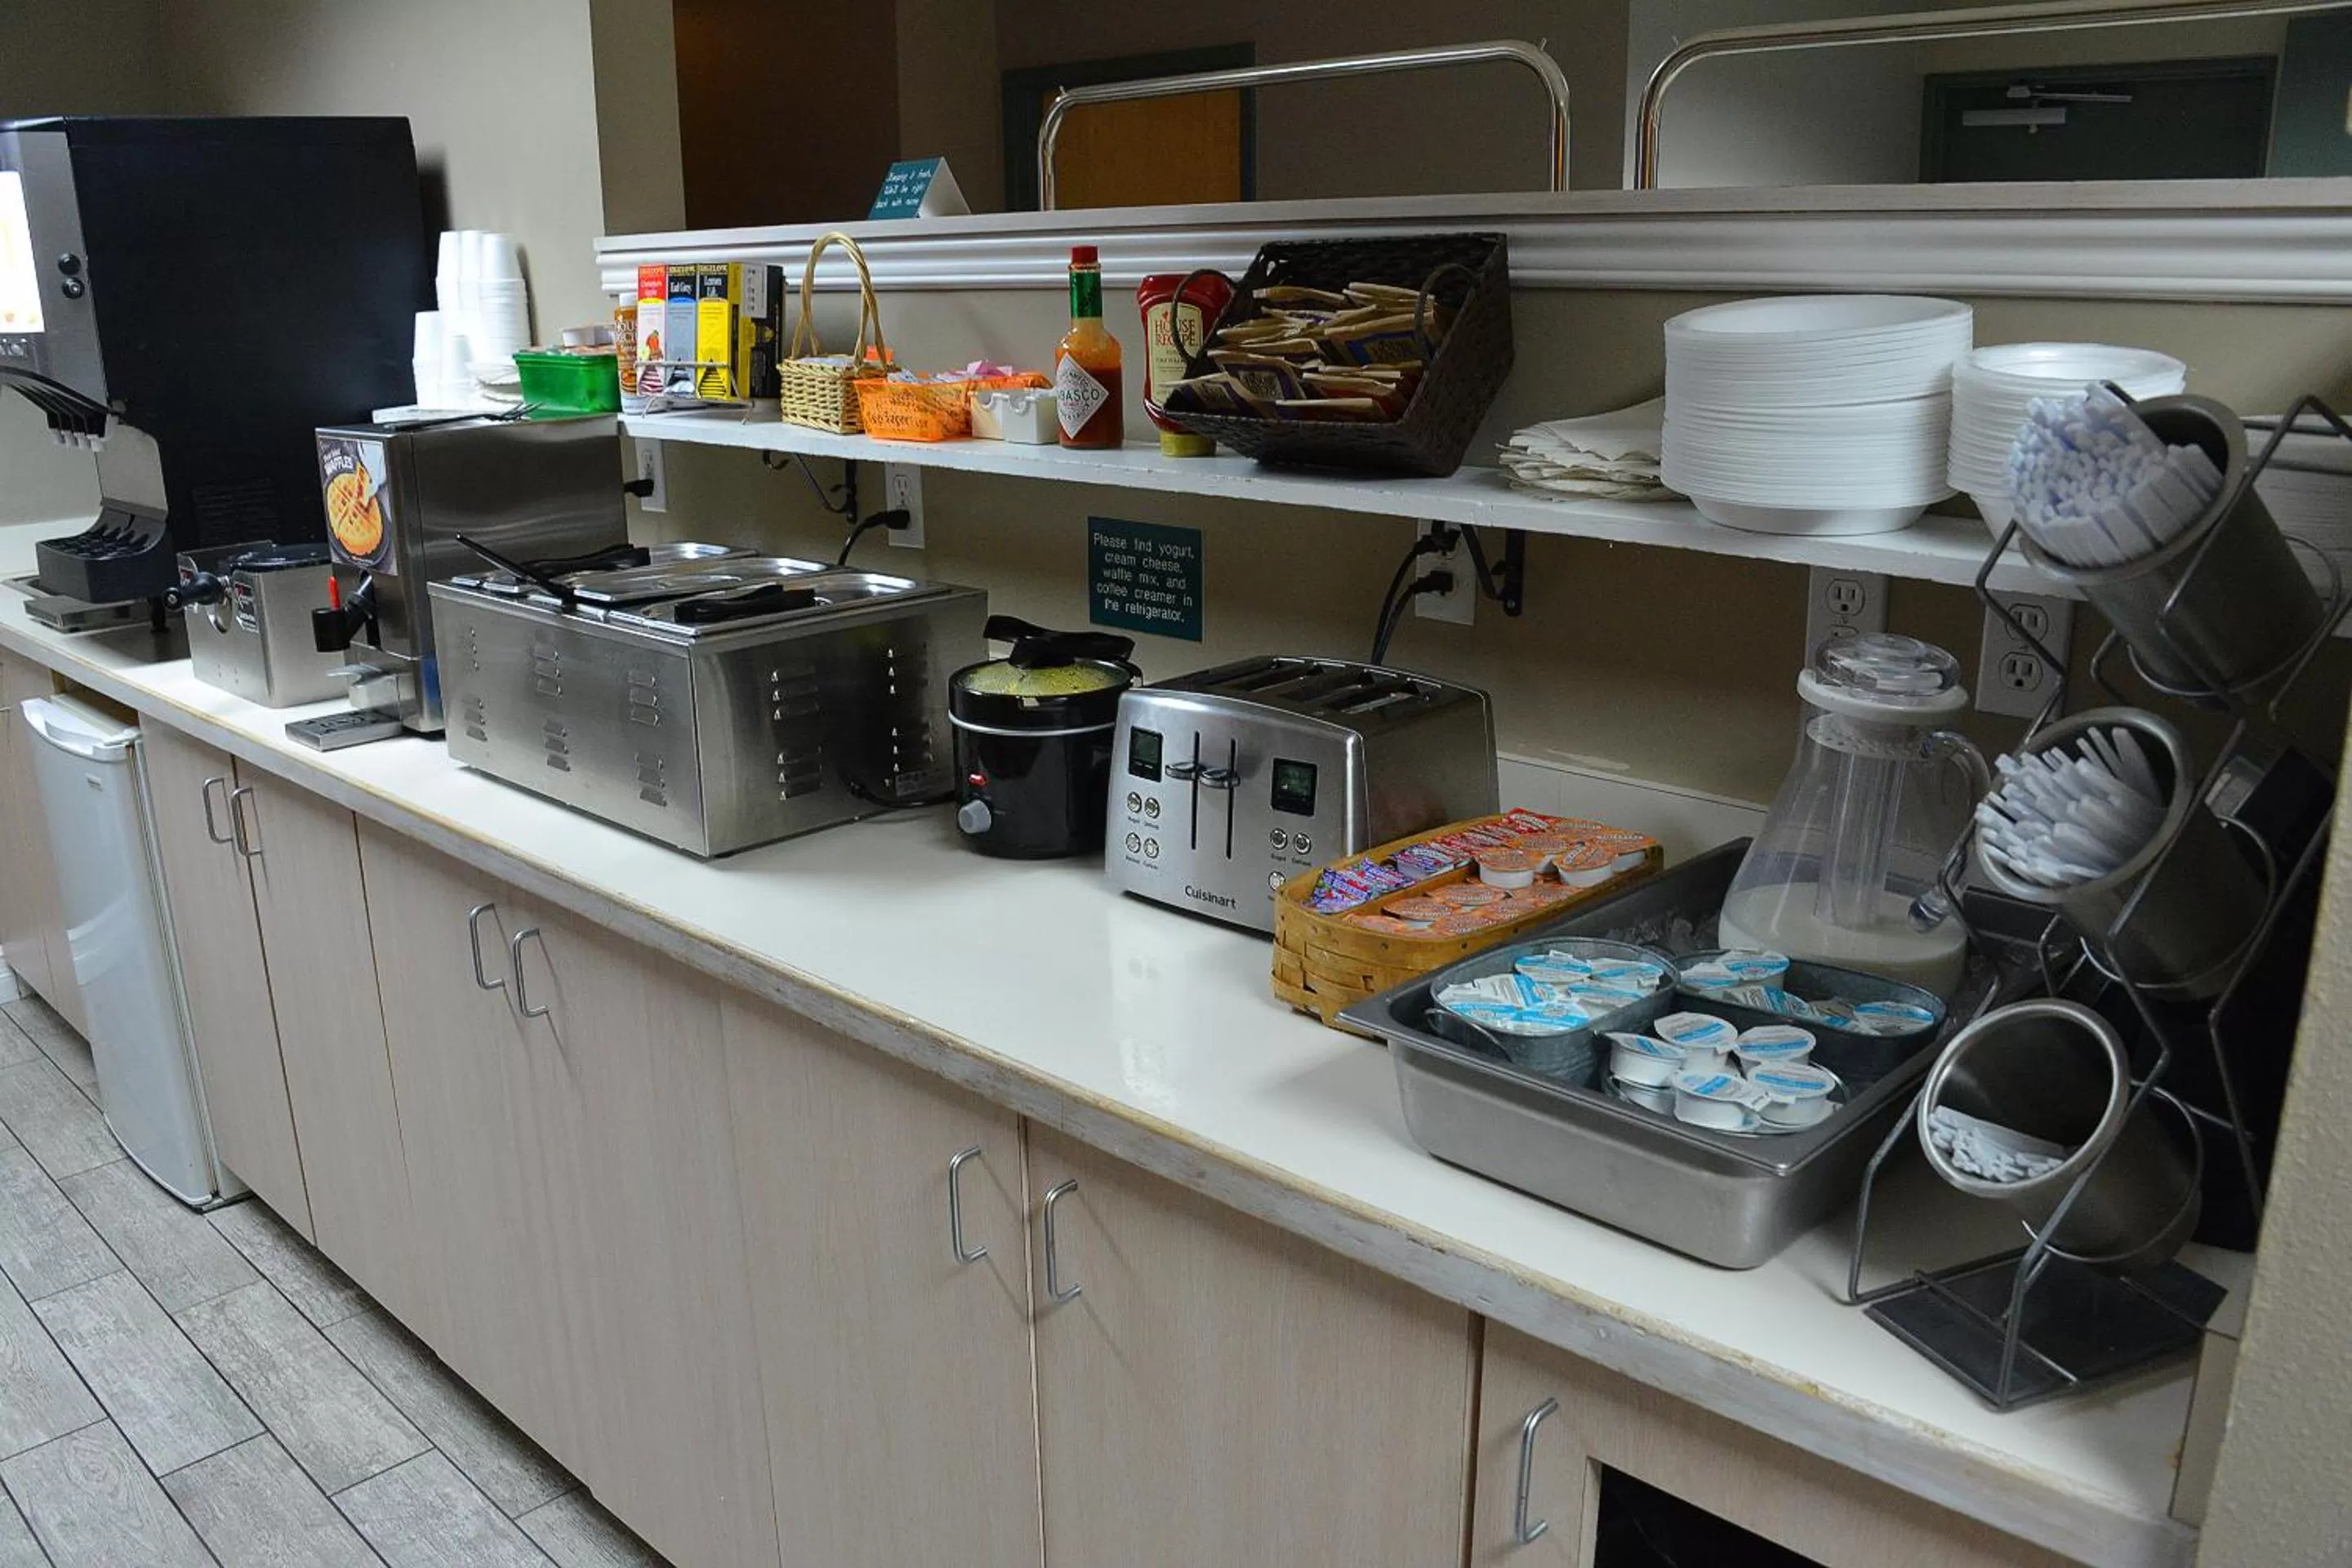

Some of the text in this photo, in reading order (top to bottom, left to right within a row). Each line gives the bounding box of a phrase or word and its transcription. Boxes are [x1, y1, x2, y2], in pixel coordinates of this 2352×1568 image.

[1057, 389, 1100, 401] BASCO
[1094, 532, 1195, 559] Please find yogurt,
[1104, 551, 1183, 573] cream cheese,
[1096, 582, 1193, 607] coffee creamer in
[1165, 577, 1187, 590] and
[1104, 598, 1184, 623] the refrigerator.
[1185, 885, 1236, 910] Cuisinart
